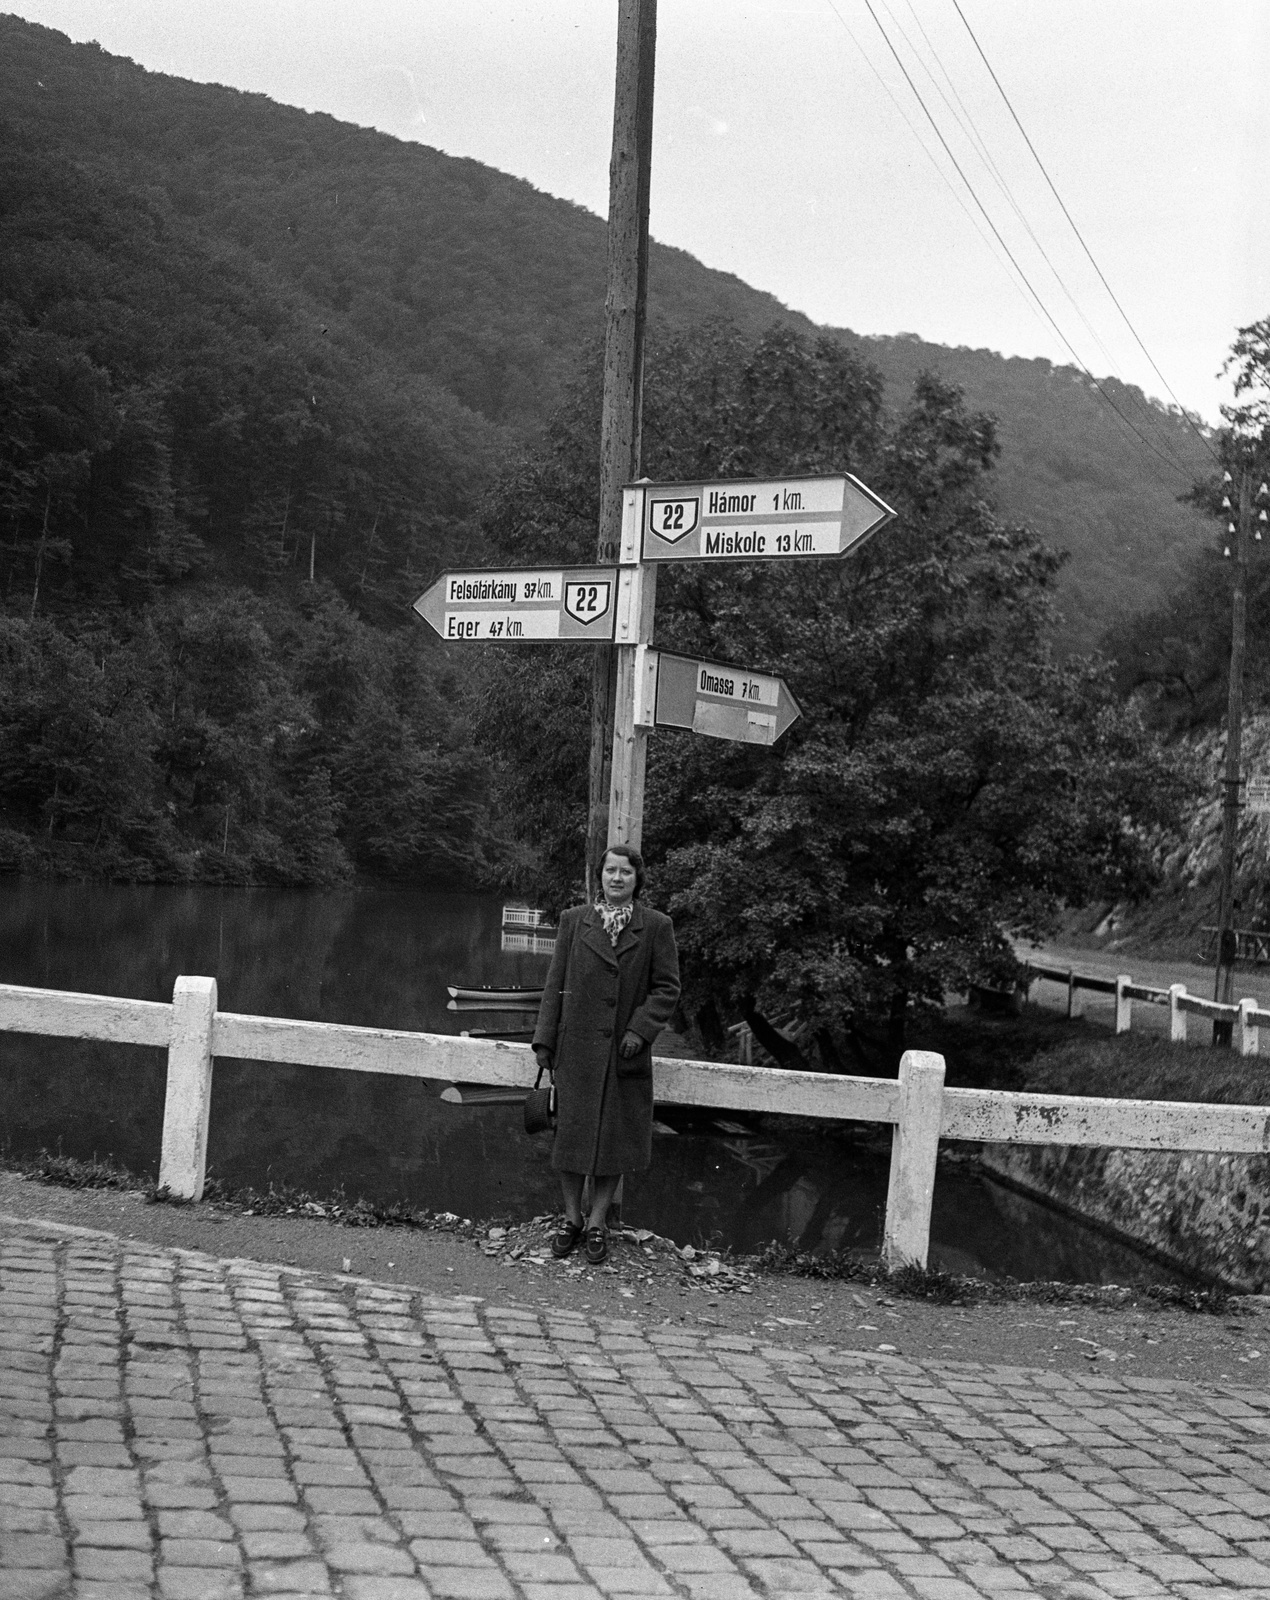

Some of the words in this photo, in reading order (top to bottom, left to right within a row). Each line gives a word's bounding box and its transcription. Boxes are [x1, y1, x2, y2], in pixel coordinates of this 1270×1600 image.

[709, 491, 757, 514] Hámor
[772, 496, 779, 511] 1
[783, 488, 805, 511] km.
[663, 504, 684, 530] 22
[706, 531, 766, 554] Miskolc
[776, 536, 791, 552] 13
[793, 530, 816, 552] km.
[450, 579, 517, 602] Felsőtárkány
[524, 583, 537, 599] 37
[576, 587, 598, 612] 22
[448, 616, 480, 638] Eger
[489, 621, 504, 637] 47
[506, 616, 525, 637] km.
[701, 671, 734, 695] Omassa
[742, 683, 748, 697] 7
[749, 680, 761, 700] km.
